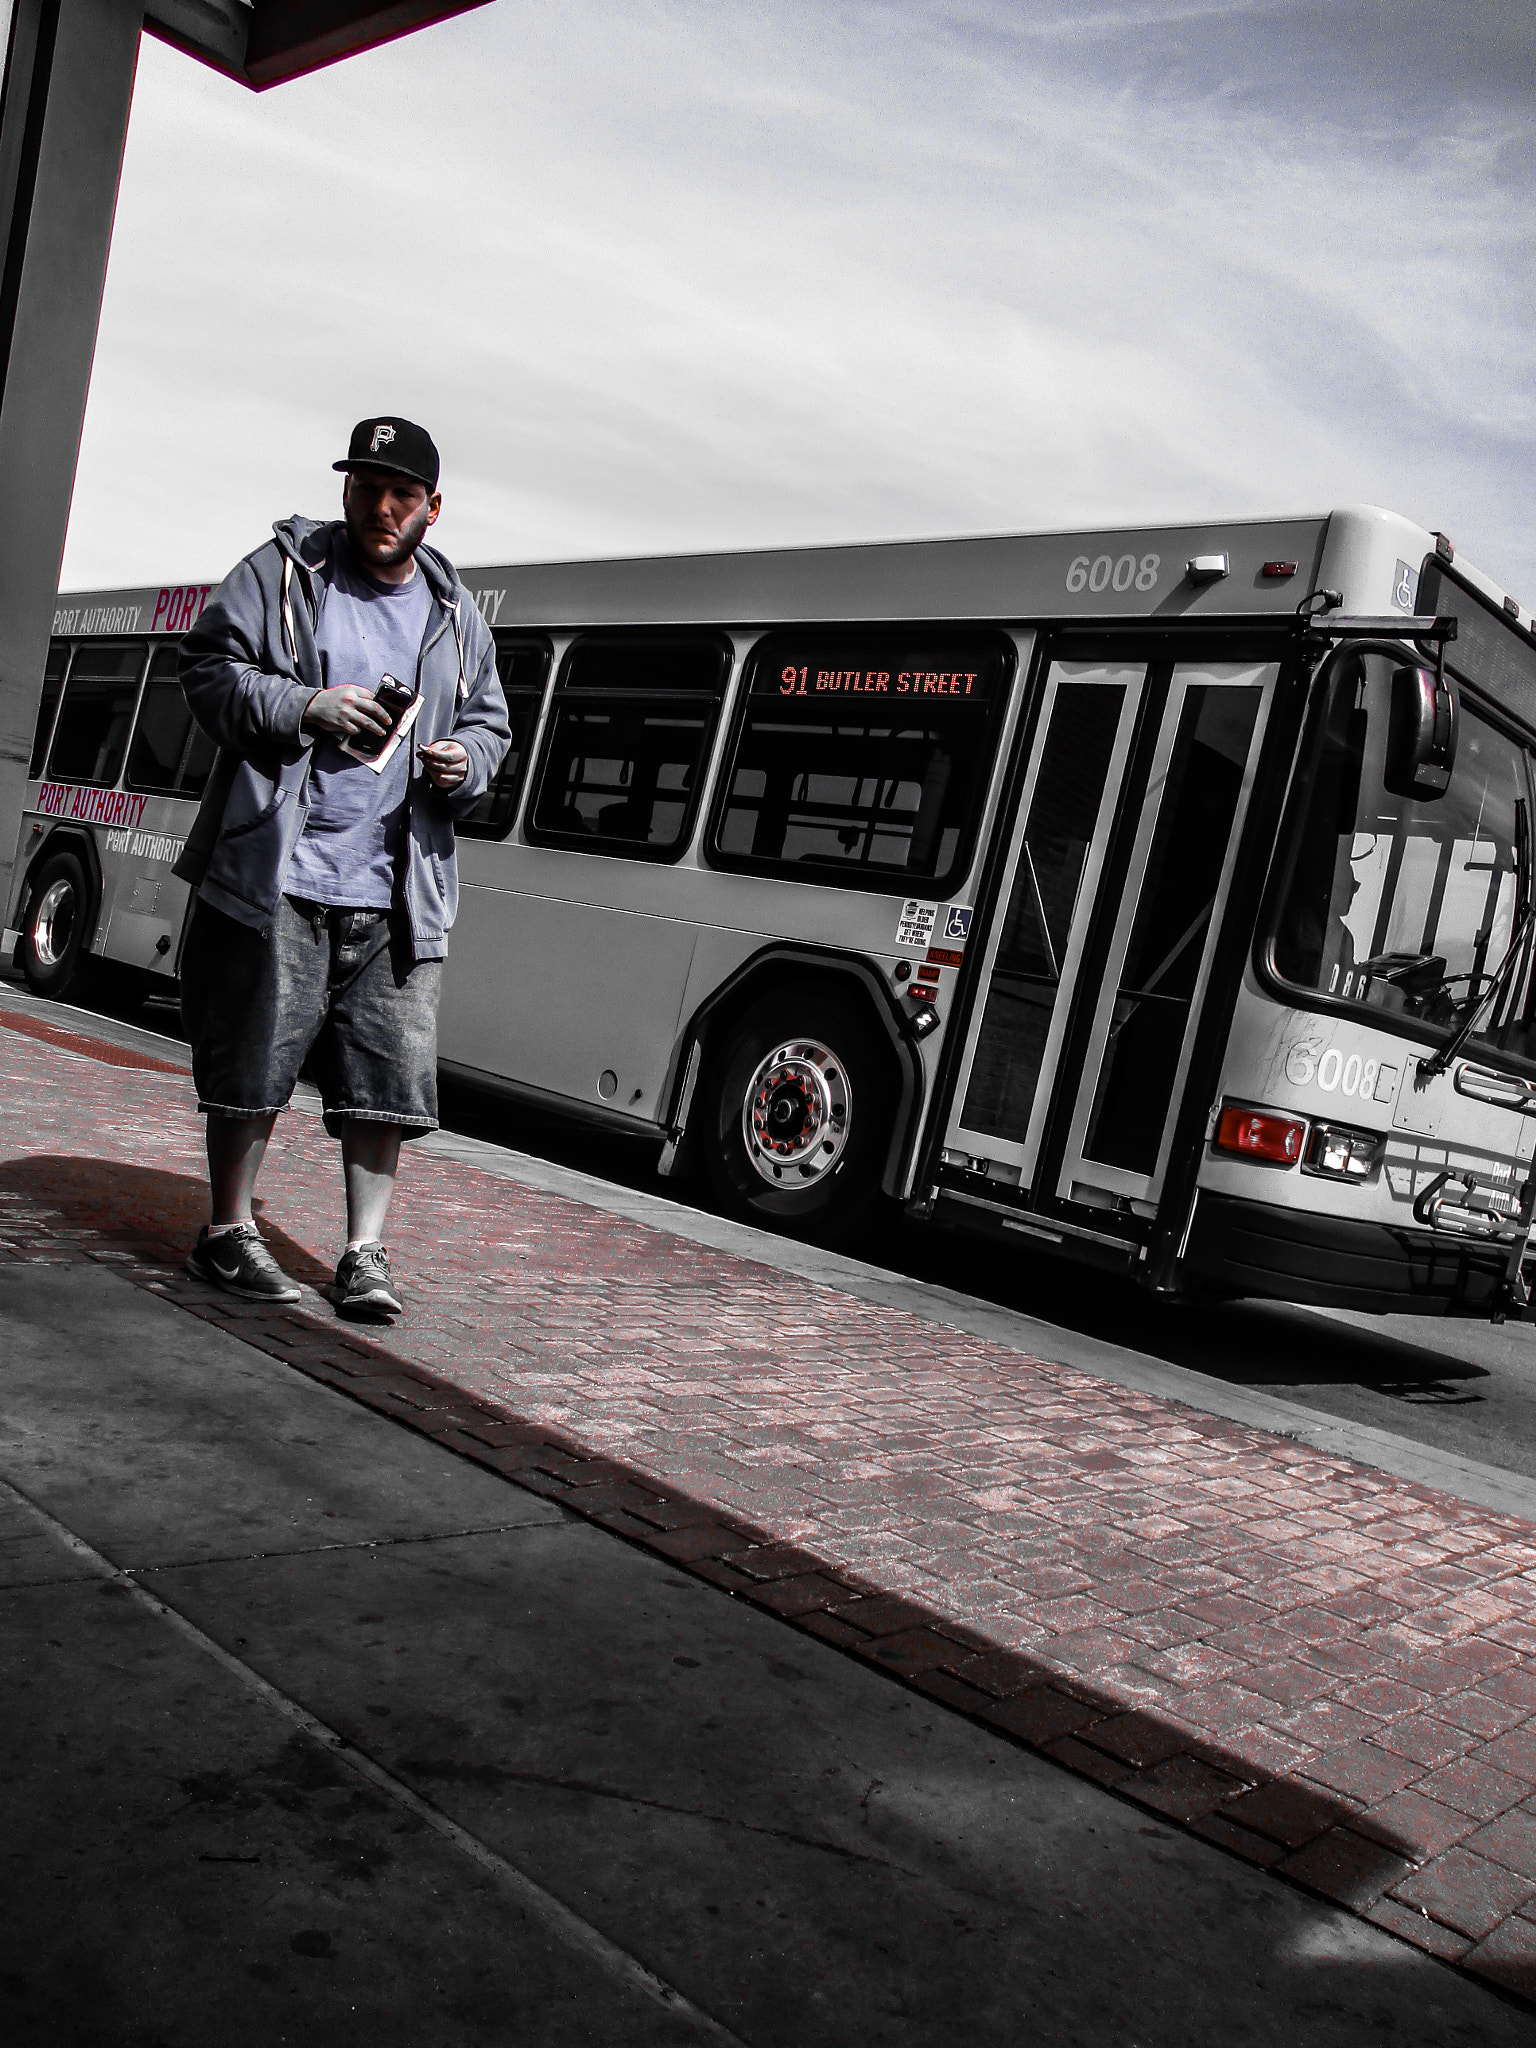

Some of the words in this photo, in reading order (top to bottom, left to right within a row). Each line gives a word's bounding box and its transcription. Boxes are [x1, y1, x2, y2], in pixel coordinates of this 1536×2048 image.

[371, 424, 396, 451] P
[1066, 553, 1160, 593] 6008
[52, 609, 81, 634] PORT
[79, 606, 142, 633] AUTHORITY
[151, 586, 211, 631] PORT
[780, 666, 808, 696] 91
[816, 671, 890, 692] BUTLER
[896, 672, 977, 694] STREET
[37, 783, 72, 816] PORT
[71, 788, 147, 827] AUTHORITY
[105, 829, 132, 853] PORT
[130, 833, 184, 864] AUTHORIT
[930, 950, 961, 963] KNEELING
[1285, 1041, 1377, 1100] 6008
